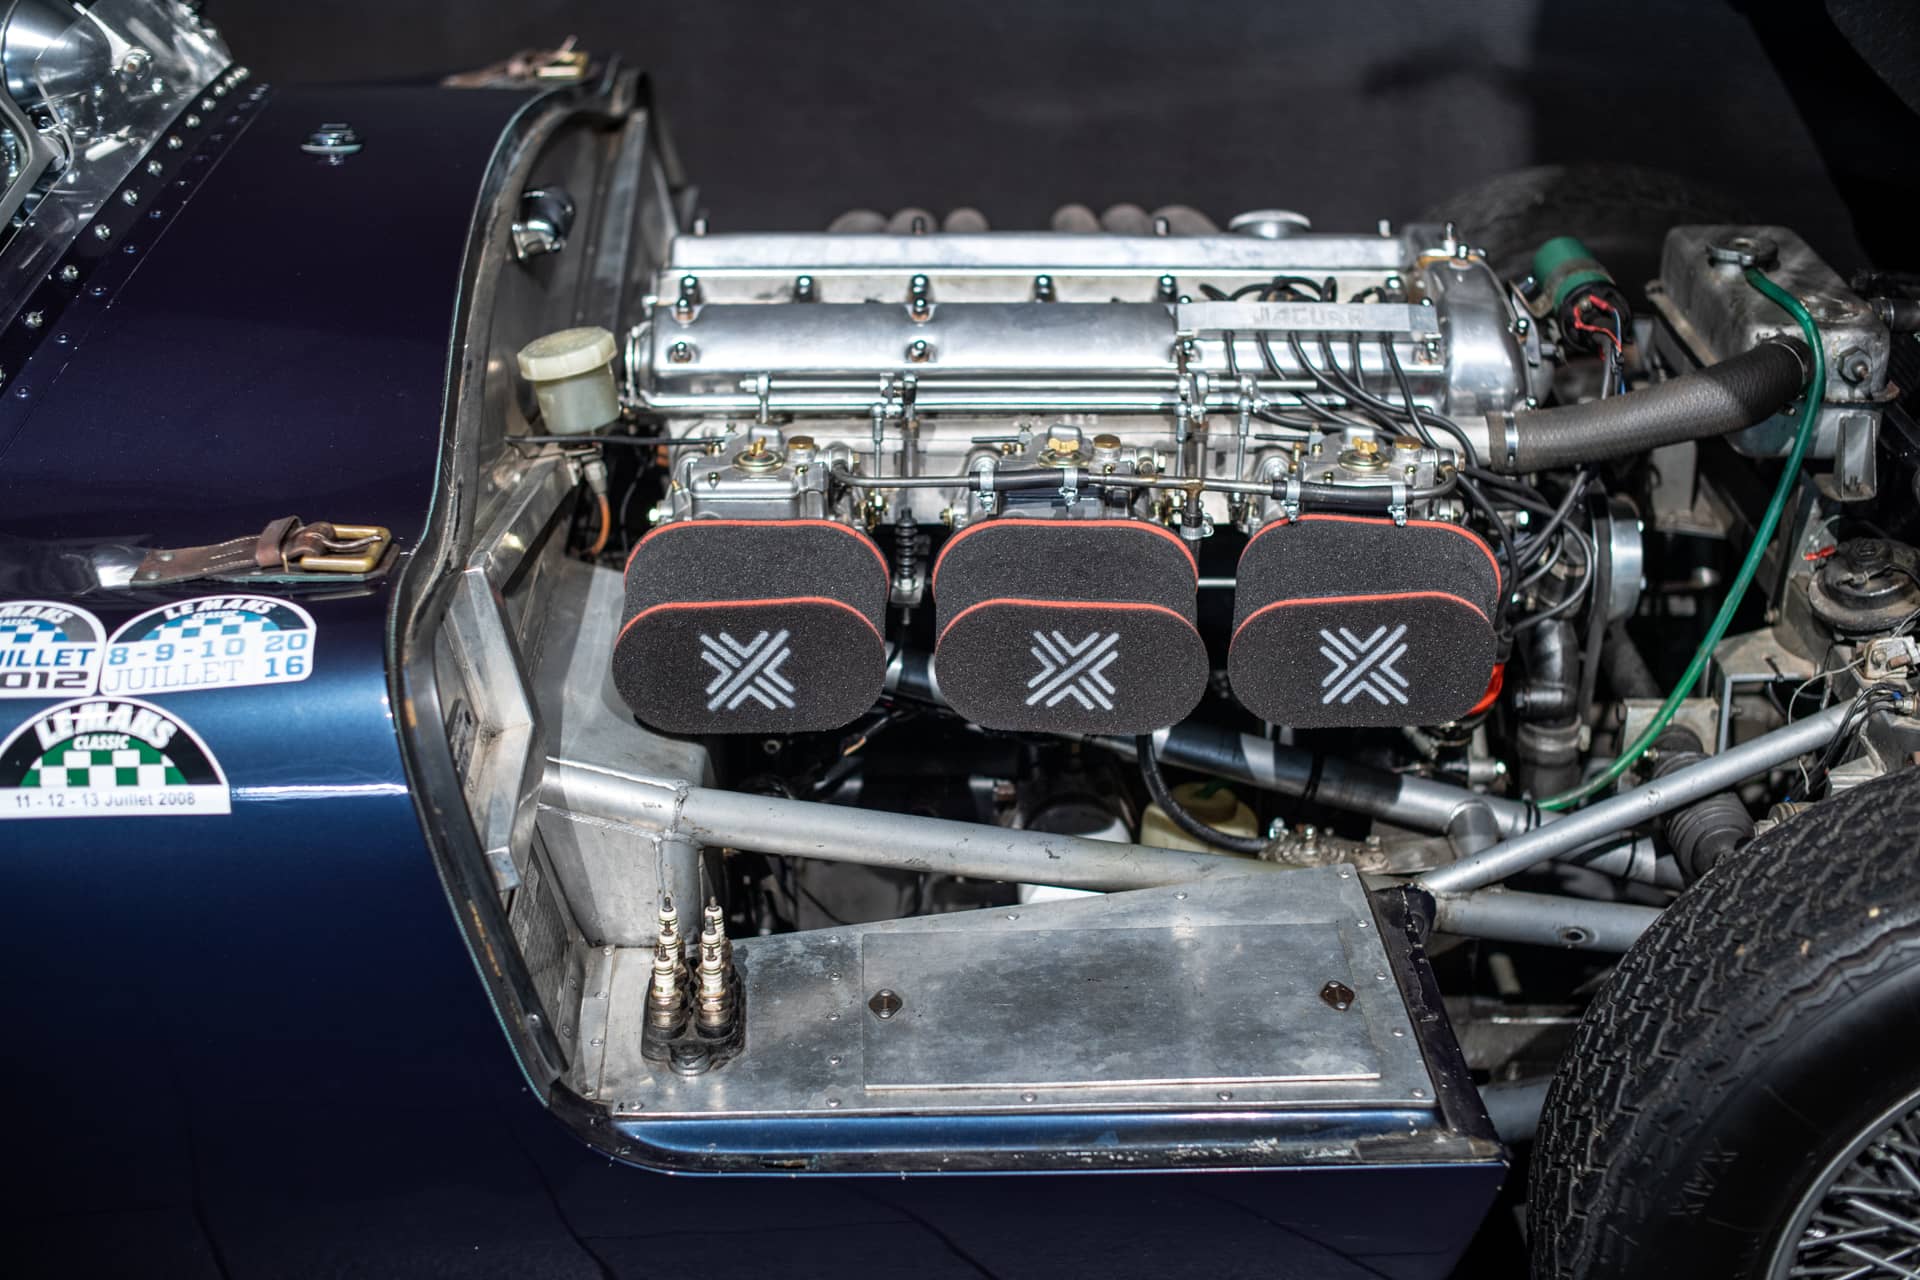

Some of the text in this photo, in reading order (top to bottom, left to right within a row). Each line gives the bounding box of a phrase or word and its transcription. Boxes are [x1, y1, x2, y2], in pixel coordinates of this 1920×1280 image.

[166, 599, 277, 620] LE MANS
[264, 632, 308, 653] 20
[0, 649, 96, 667] ILLET
[264, 655, 305, 678] 16
[105, 660, 243, 692] JUILLET
[34, 701, 178, 751] LE MANS
[74, 736, 130, 750] CLASSIC
[15, 794, 31, 808] 11
[49, 793, 65, 808] 12
[82, 792, 99, 807] 13
